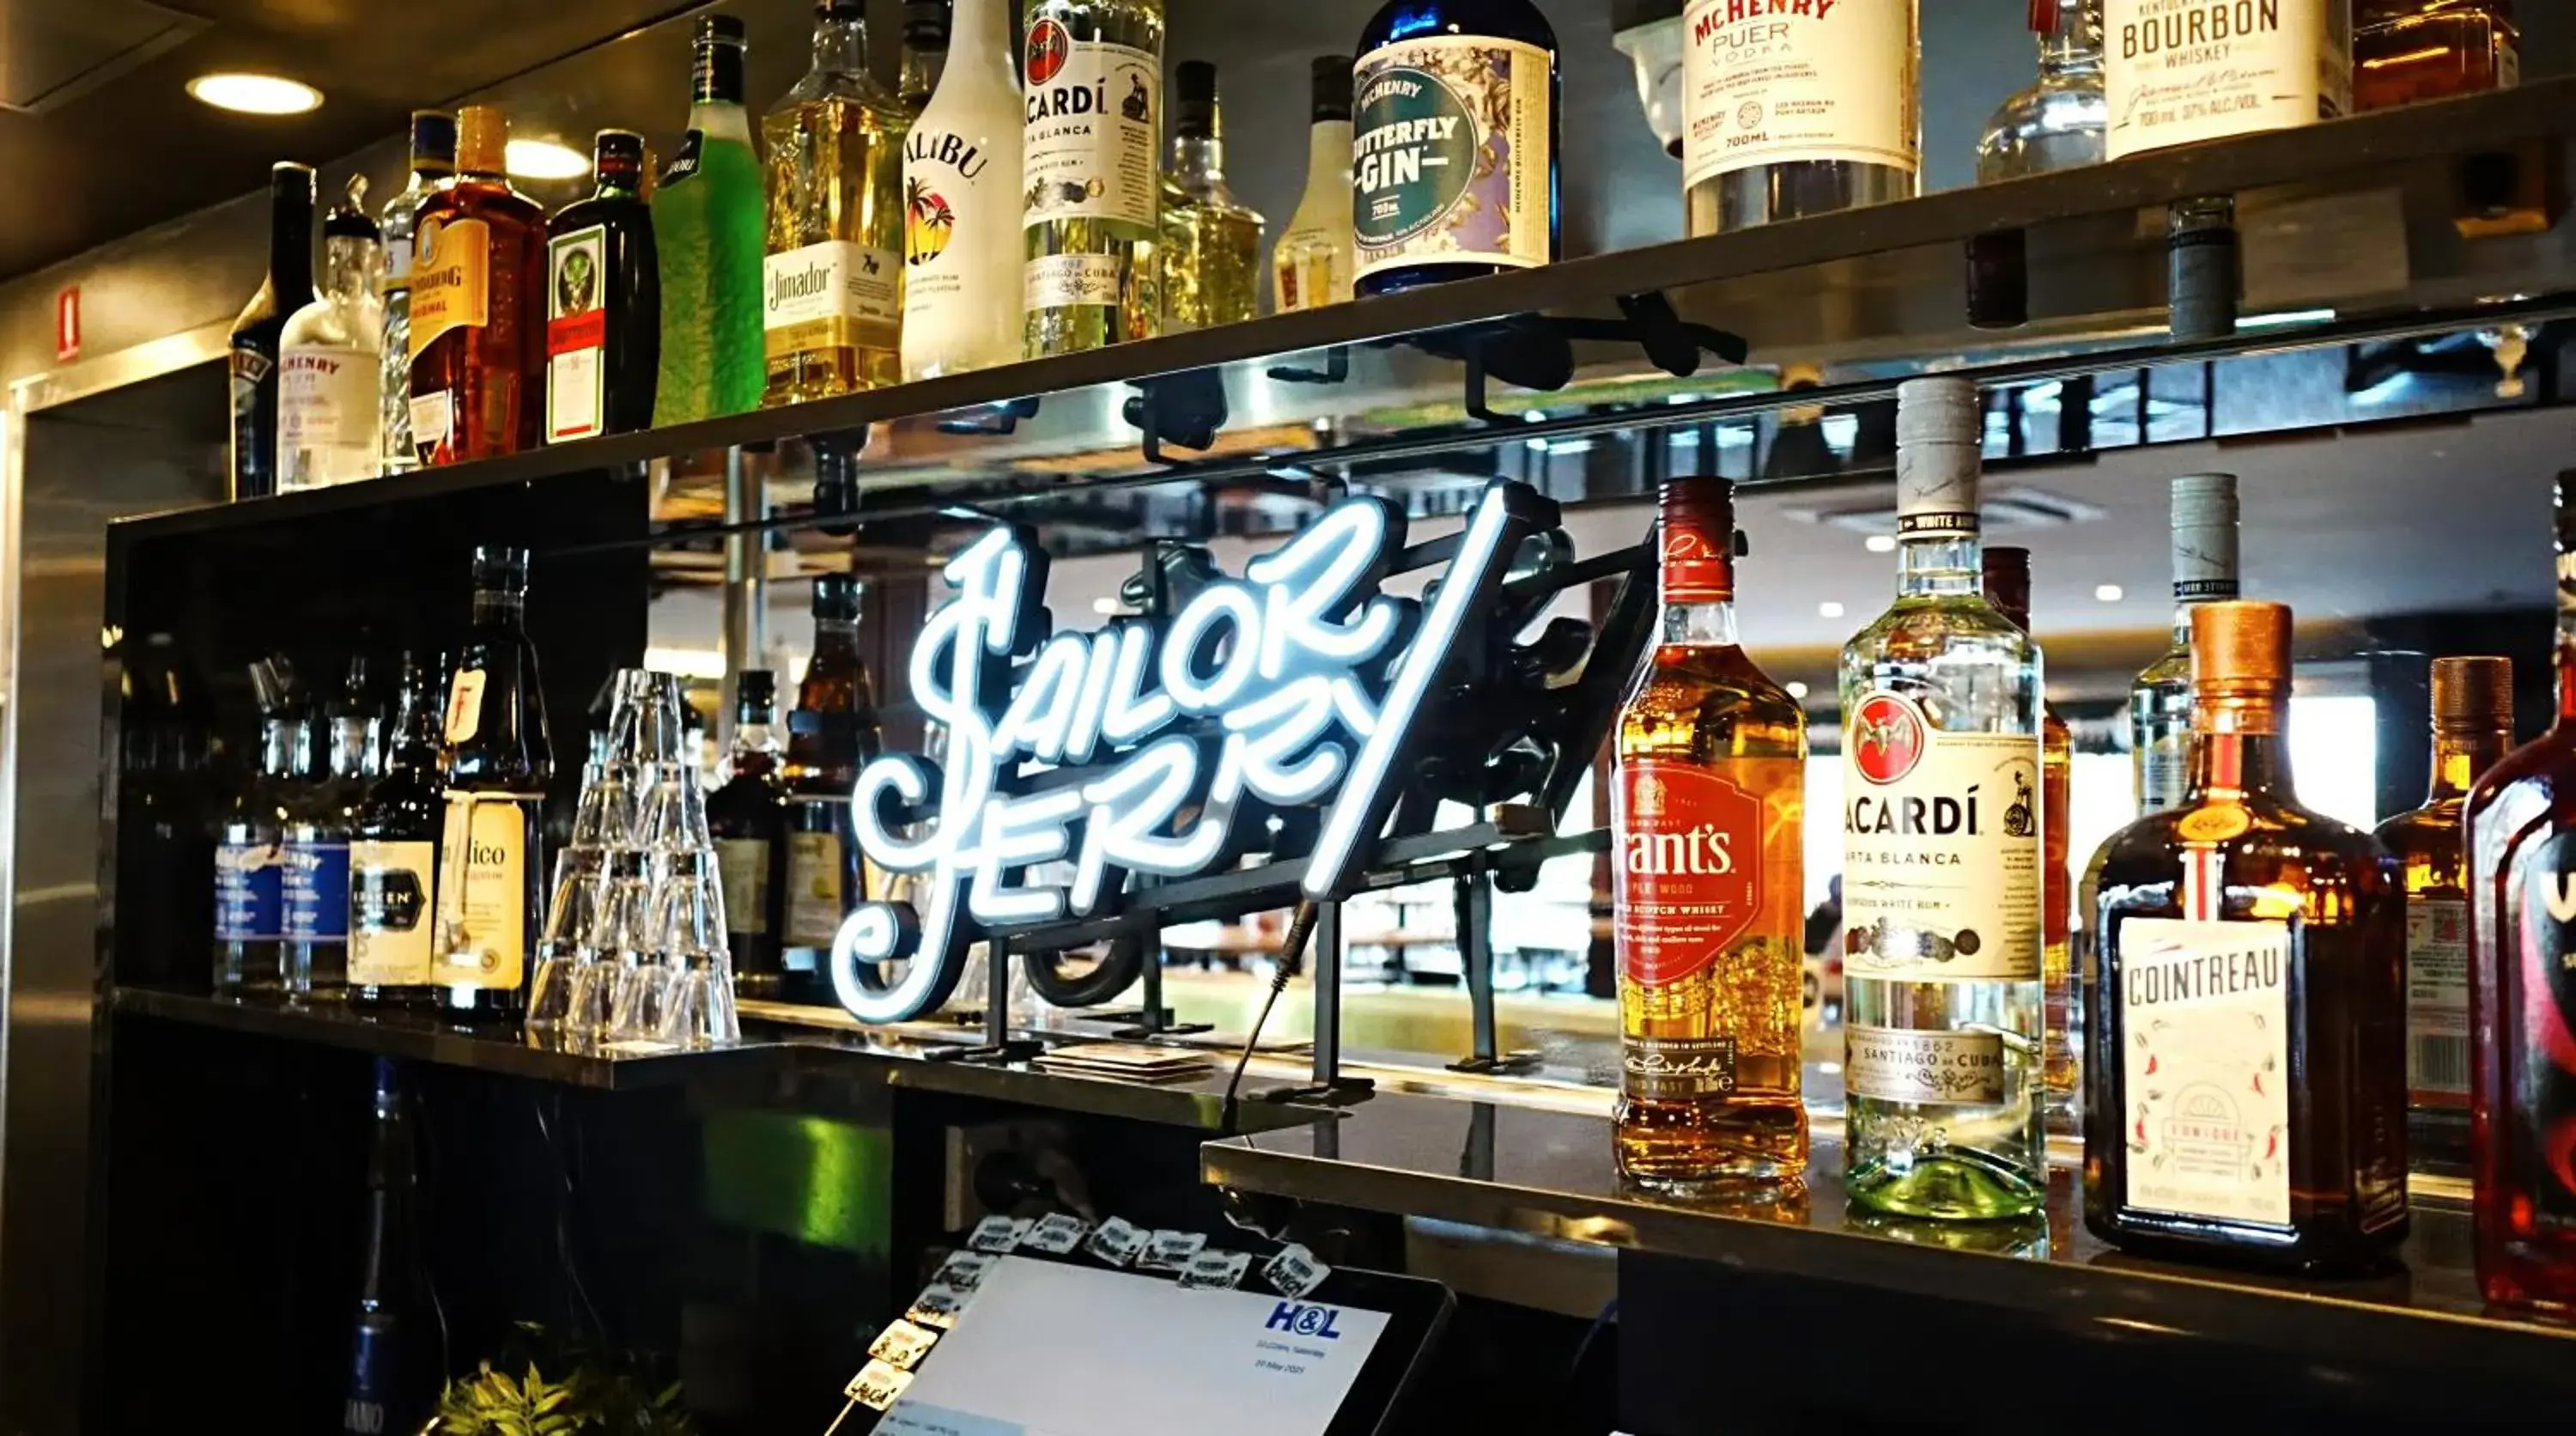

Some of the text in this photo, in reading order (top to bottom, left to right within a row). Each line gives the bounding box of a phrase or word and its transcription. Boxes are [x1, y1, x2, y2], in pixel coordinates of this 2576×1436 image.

[1712, 22, 1789, 55] PUER
[2123, 0, 2278, 59] BOURBON
[2166, 44, 2231, 69] WHISKEY
[1026, 77, 1106, 125] CARDÍ
[905, 131, 987, 180] ALIBU
[1361, 147, 1421, 195] GIN
[769, 261, 830, 312] Jimador
[284, 355, 340, 375] HENRY
[1844, 785, 1979, 836] ACARDÍ
[1625, 824, 1732, 875] rant's
[1880, 851, 1962, 865] BLANCA
[2129, 947, 2278, 1007] COINTREAU
[1864, 1046, 1938, 1066] SANTIAGO
[1264, 1300, 1341, 1340] H&L
